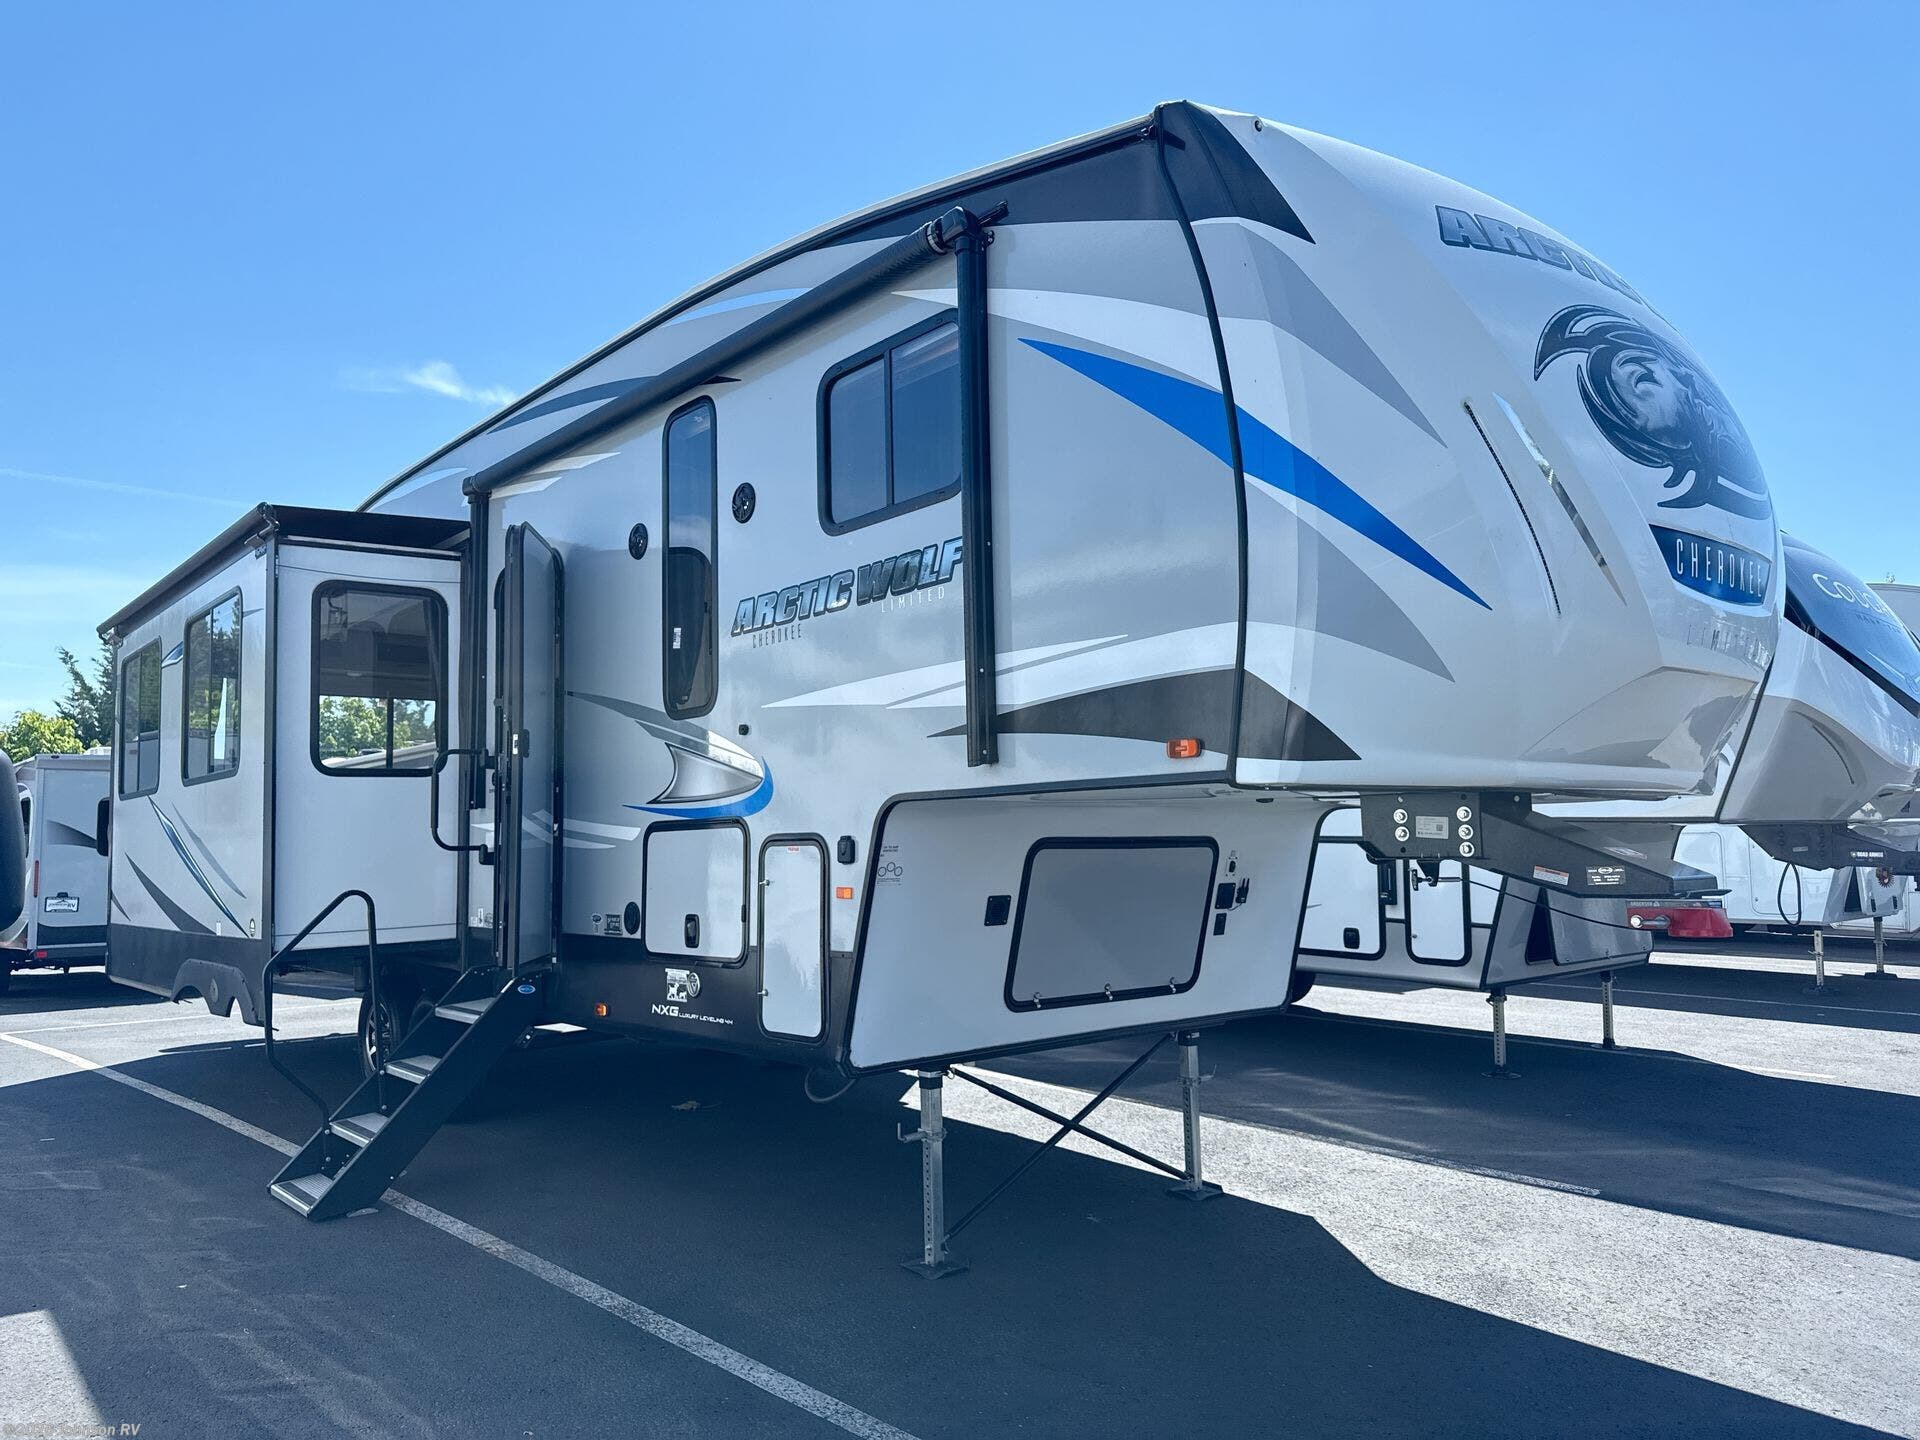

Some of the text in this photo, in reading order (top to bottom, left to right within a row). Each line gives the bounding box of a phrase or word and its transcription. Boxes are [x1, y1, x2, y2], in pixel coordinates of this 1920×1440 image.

[1676, 538, 1762, 597] CHEROKEE
[731, 536, 963, 637] ARCTIC WOLF
[881, 586, 945, 613] LIMITED
[752, 624, 802, 649] CHEROKEE
[651, 1003, 679, 1017] NXG
